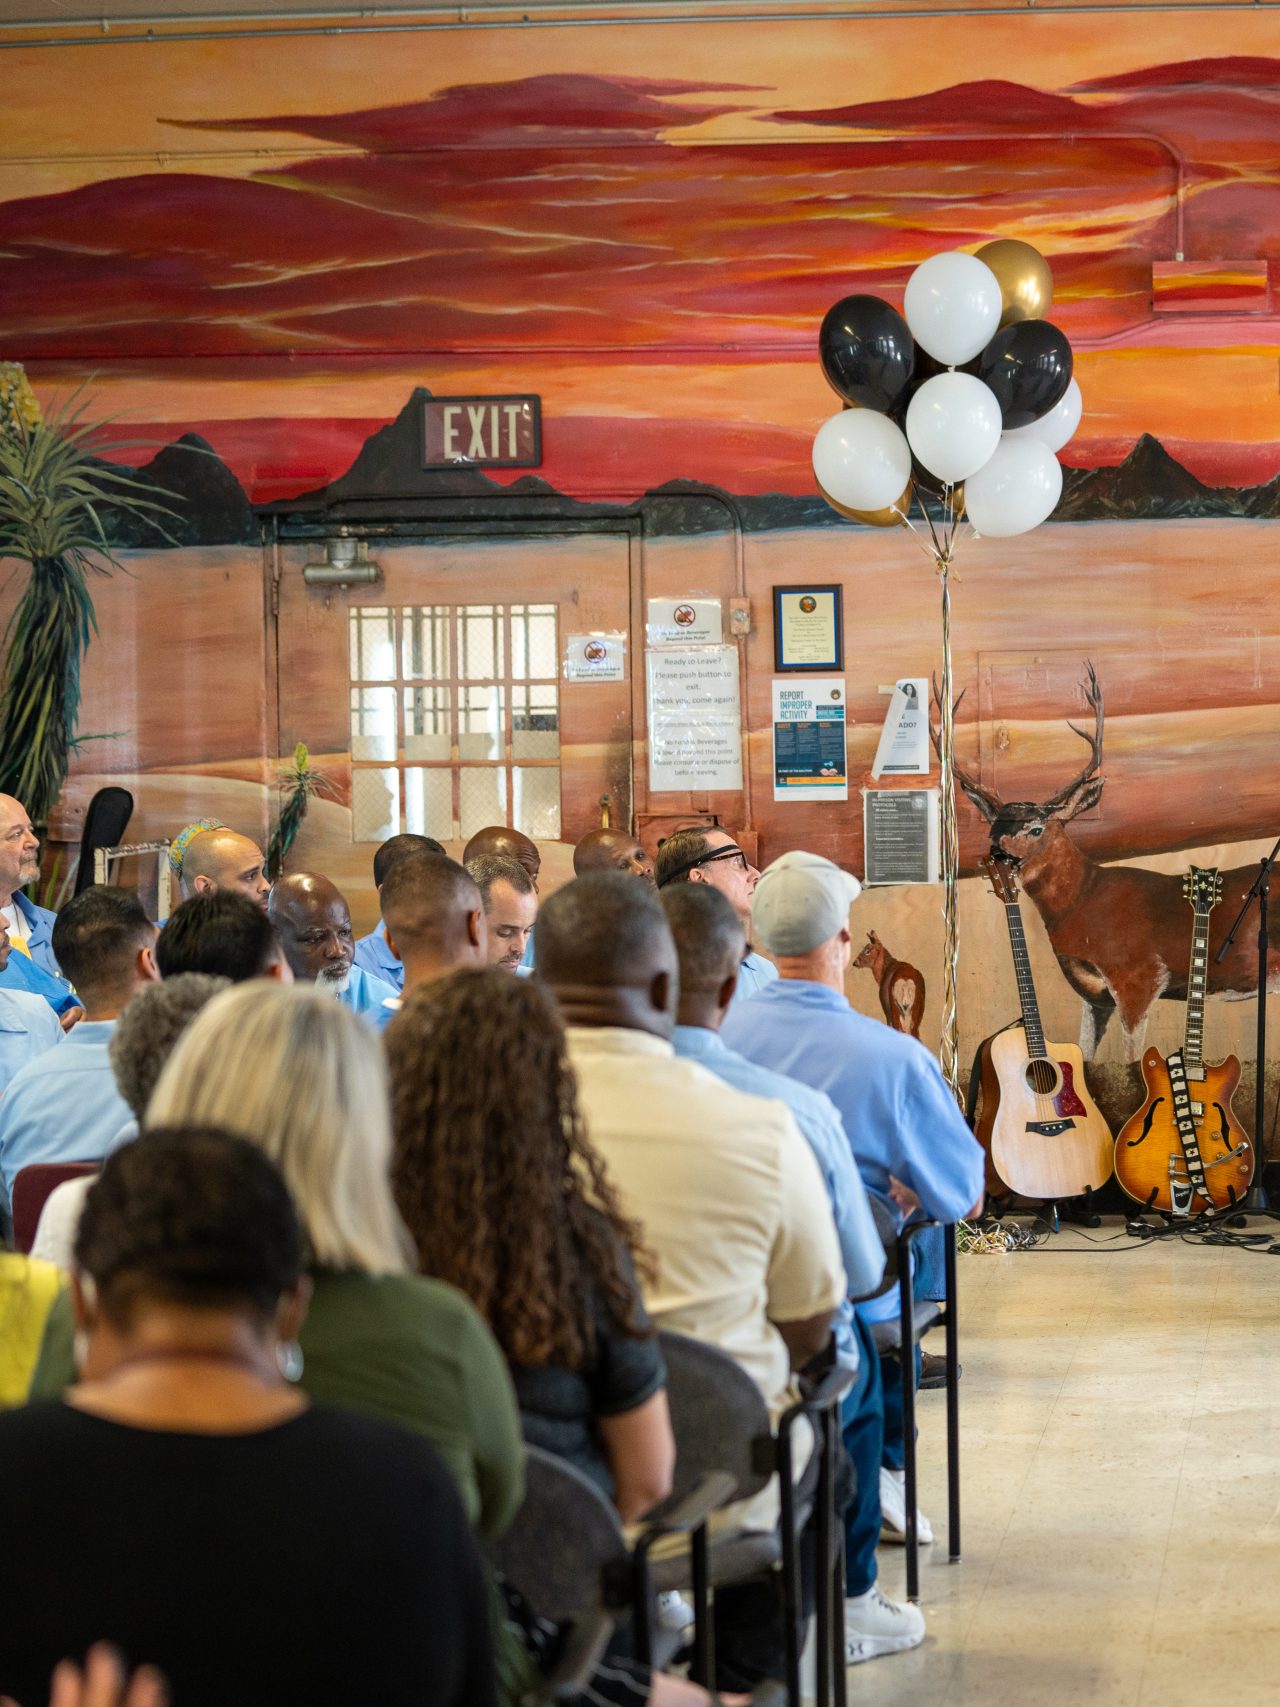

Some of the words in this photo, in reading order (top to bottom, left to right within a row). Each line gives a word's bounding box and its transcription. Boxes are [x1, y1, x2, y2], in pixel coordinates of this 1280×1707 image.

[443, 404, 521, 459] EXIT
[664, 657, 686, 667] Ready
[696, 656, 722, 665] Leave?
[679, 671, 697, 680] push
[779, 690, 805, 700] REPORT
[780, 700, 813, 710] IMPROPER
[780, 709, 808, 720] ACTIVITY
[898, 721, 917, 729] ADO?
